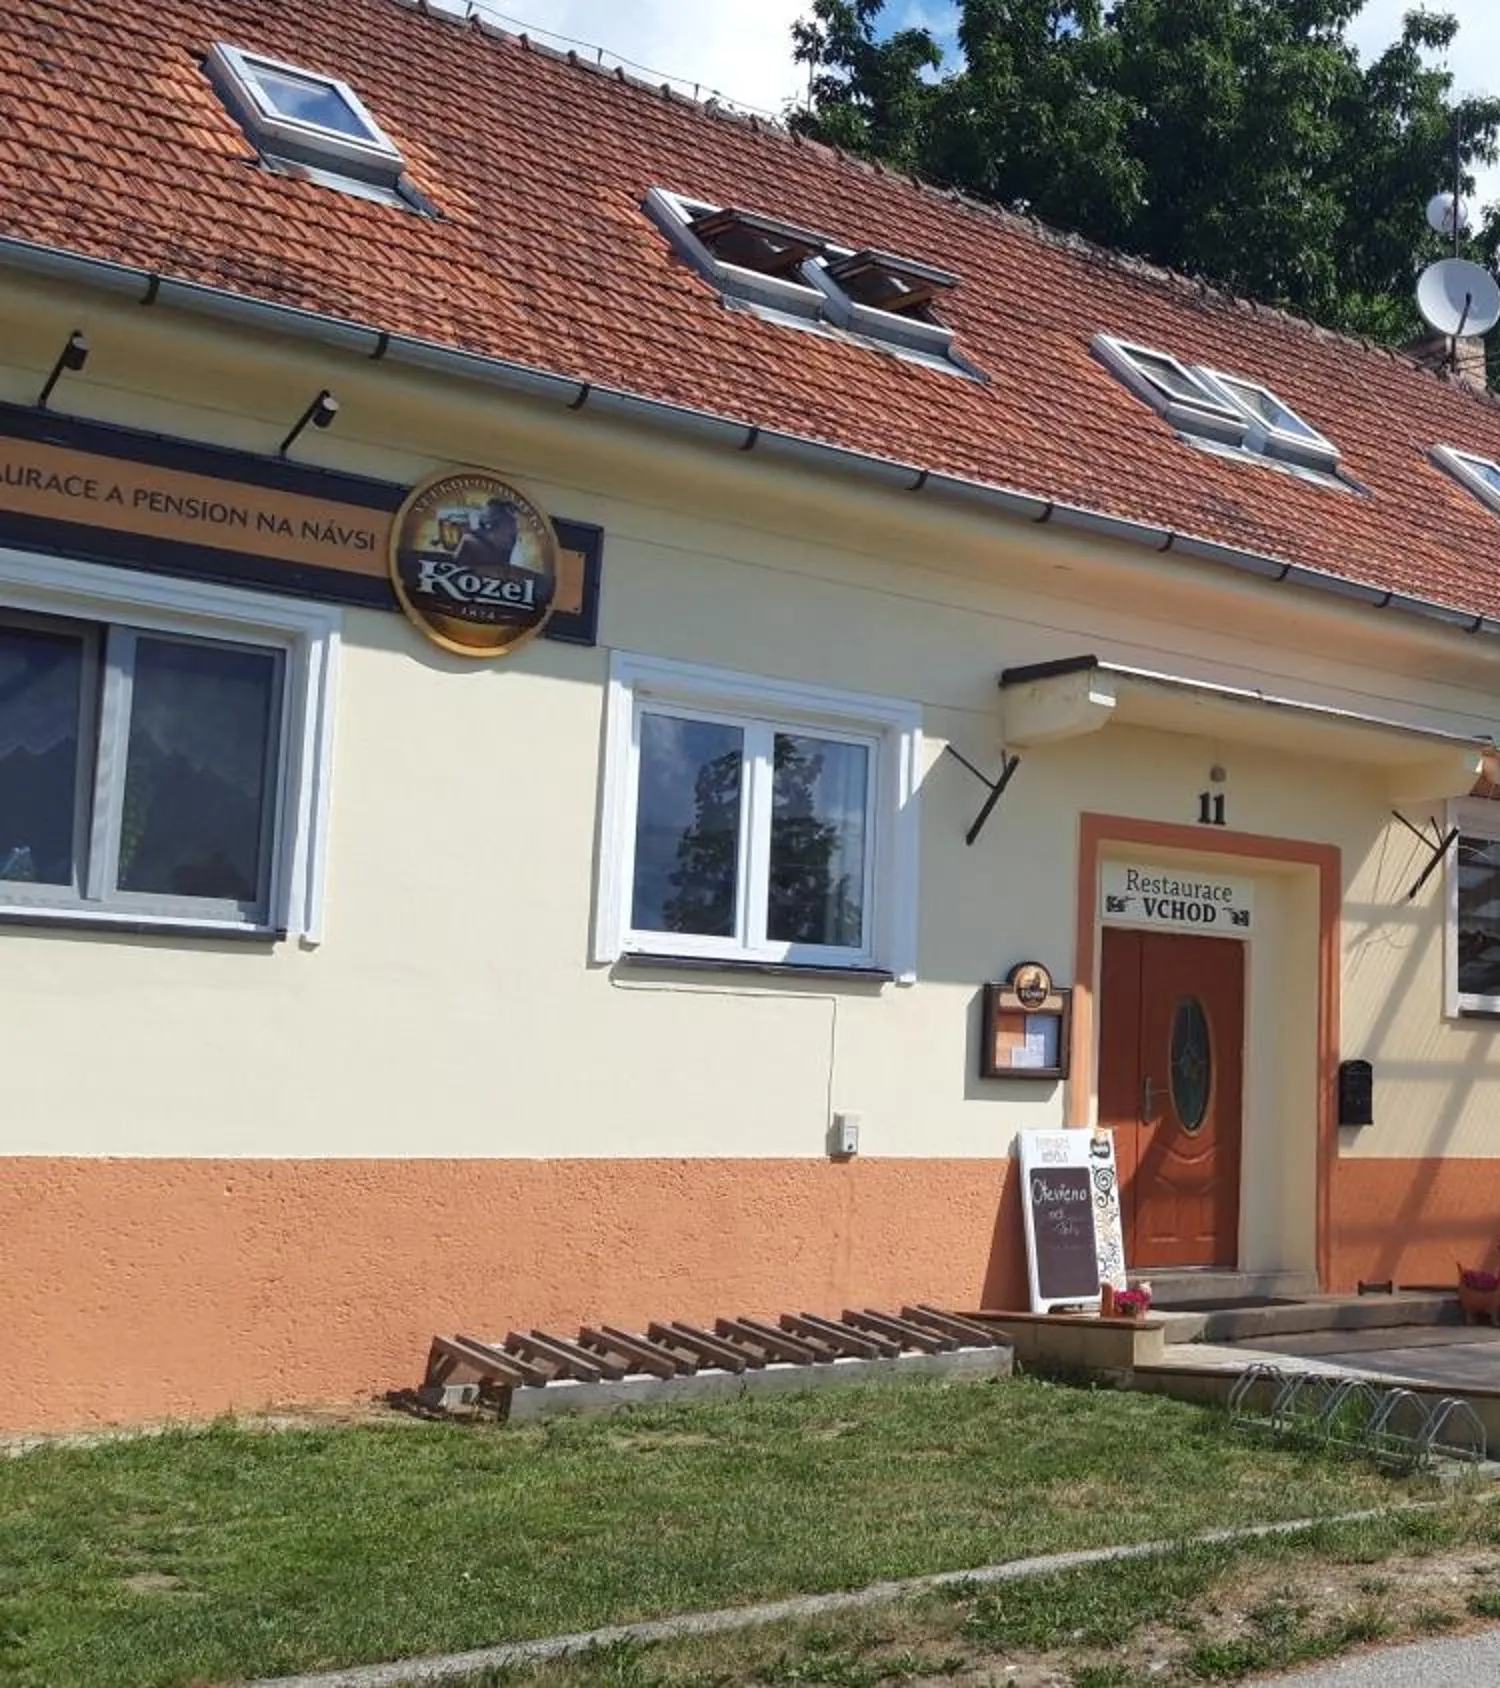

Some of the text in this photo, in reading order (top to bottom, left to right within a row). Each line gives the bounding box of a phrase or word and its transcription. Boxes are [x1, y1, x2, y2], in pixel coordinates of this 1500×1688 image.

[0, 463, 375, 551] URACE A PENSION NA NÁVSI
[416, 559, 536, 606] Kozel
[1198, 791, 1226, 826] 11
[1125, 868, 1233, 903] Restaurace
[1142, 897, 1217, 923] VCHOD
